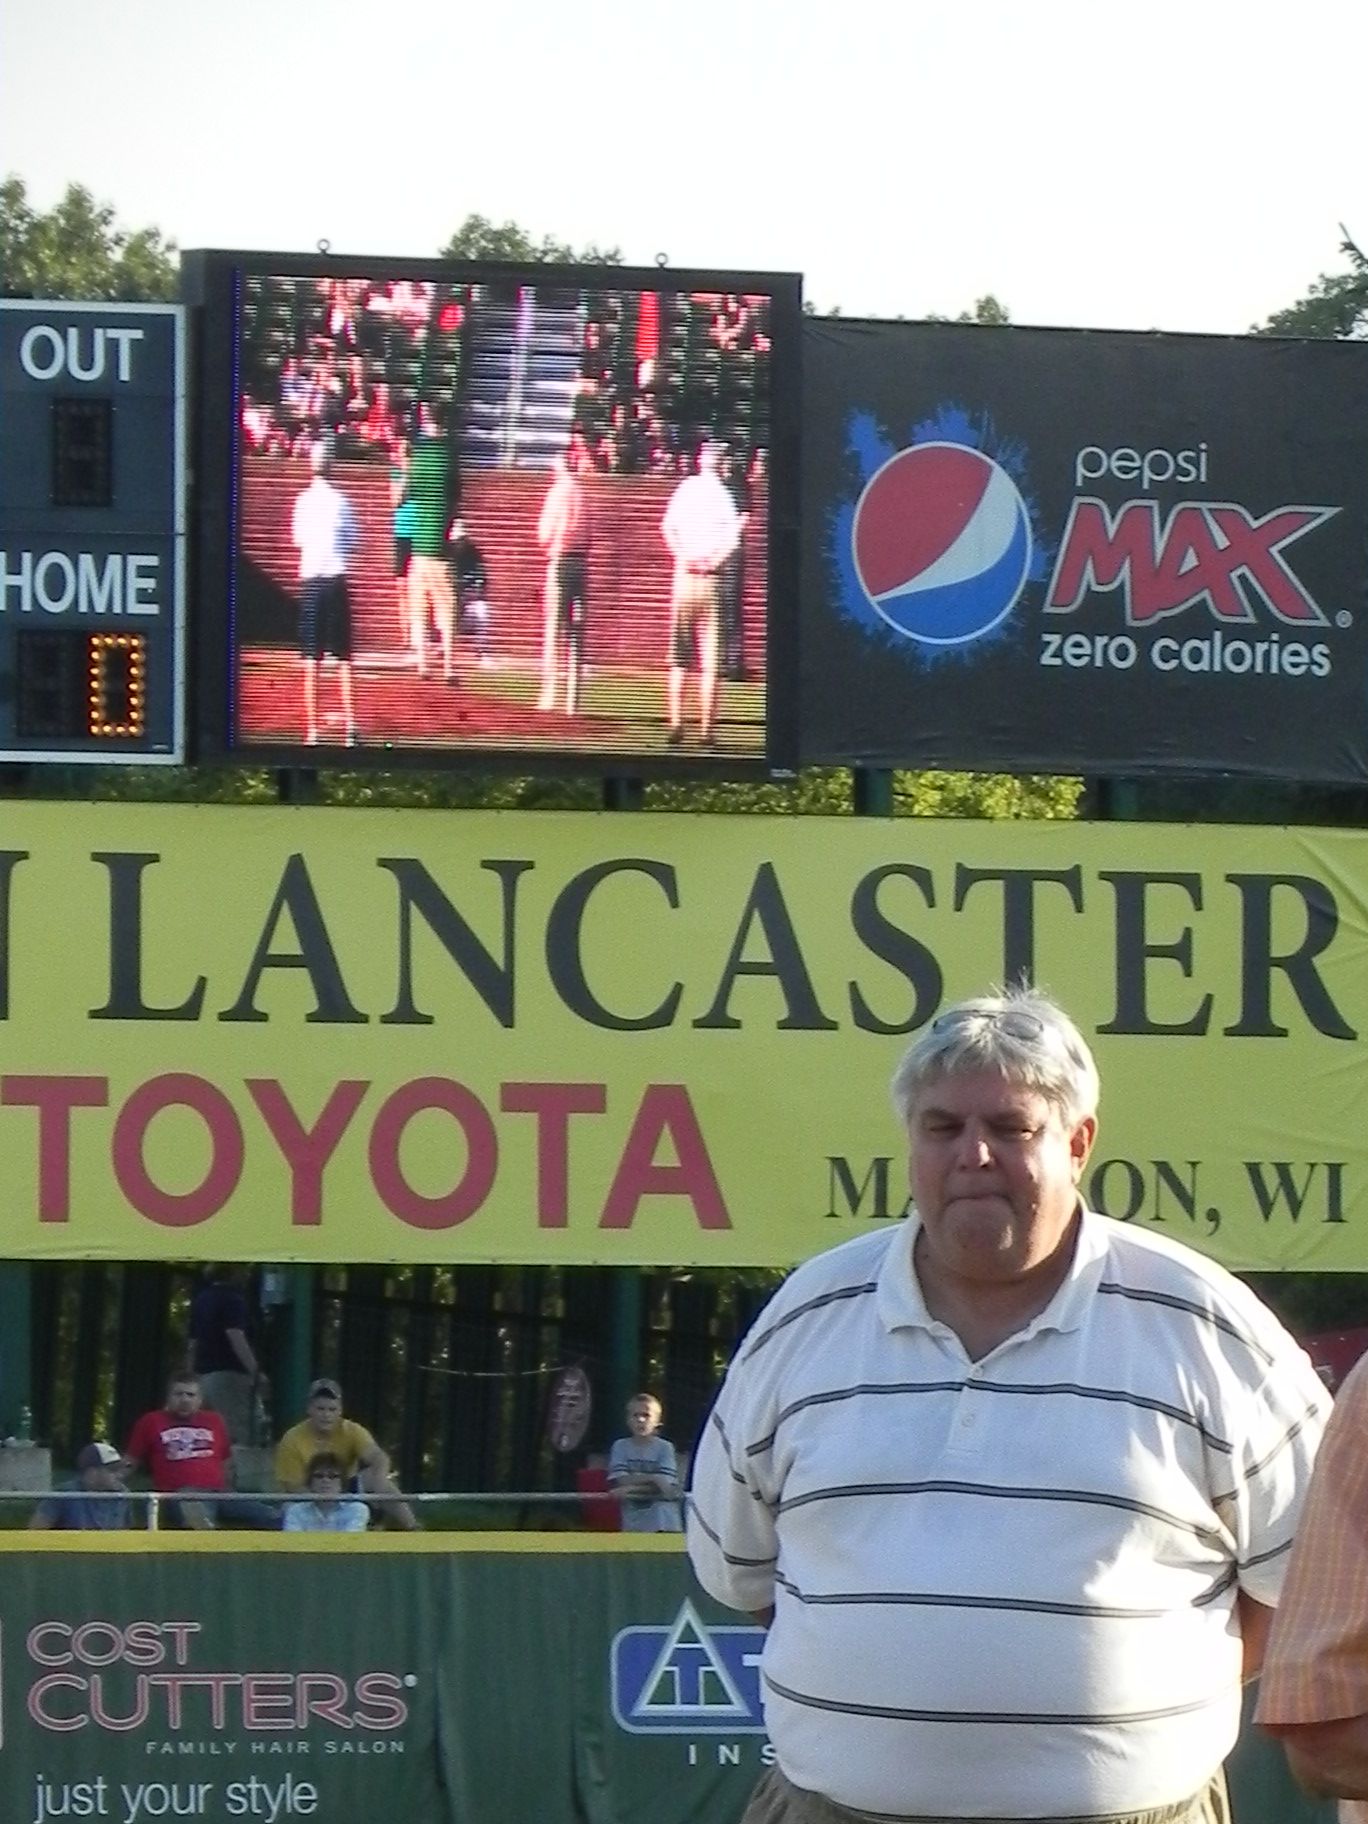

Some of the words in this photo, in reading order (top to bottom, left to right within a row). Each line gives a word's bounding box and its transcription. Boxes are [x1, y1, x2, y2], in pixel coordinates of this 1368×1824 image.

[20, 325, 145, 382] OUT
[1074, 442, 1208, 490] pepsi
[0, 551, 160, 615] HOME
[1042, 495, 1344, 627] MAX
[1039, 632, 1138, 670] zero
[1150, 630, 1332, 677] calories
[88, 852, 1358, 1041] LANCASTER
[0, 1072, 733, 1230] TOYOTA
[1243, 1160, 1350, 1223] WI
[27, 1621, 201, 1666] COST
[27, 1671, 408, 1731] CUTTERS
[145, 1741, 236, 1755] FAMILY
[251, 1741, 311, 1754] HAIR
[324, 1740, 405, 1754] SALON
[33, 1773, 108, 1824] just
[121, 1780, 213, 1824] your
[225, 1772, 318, 1824] style
